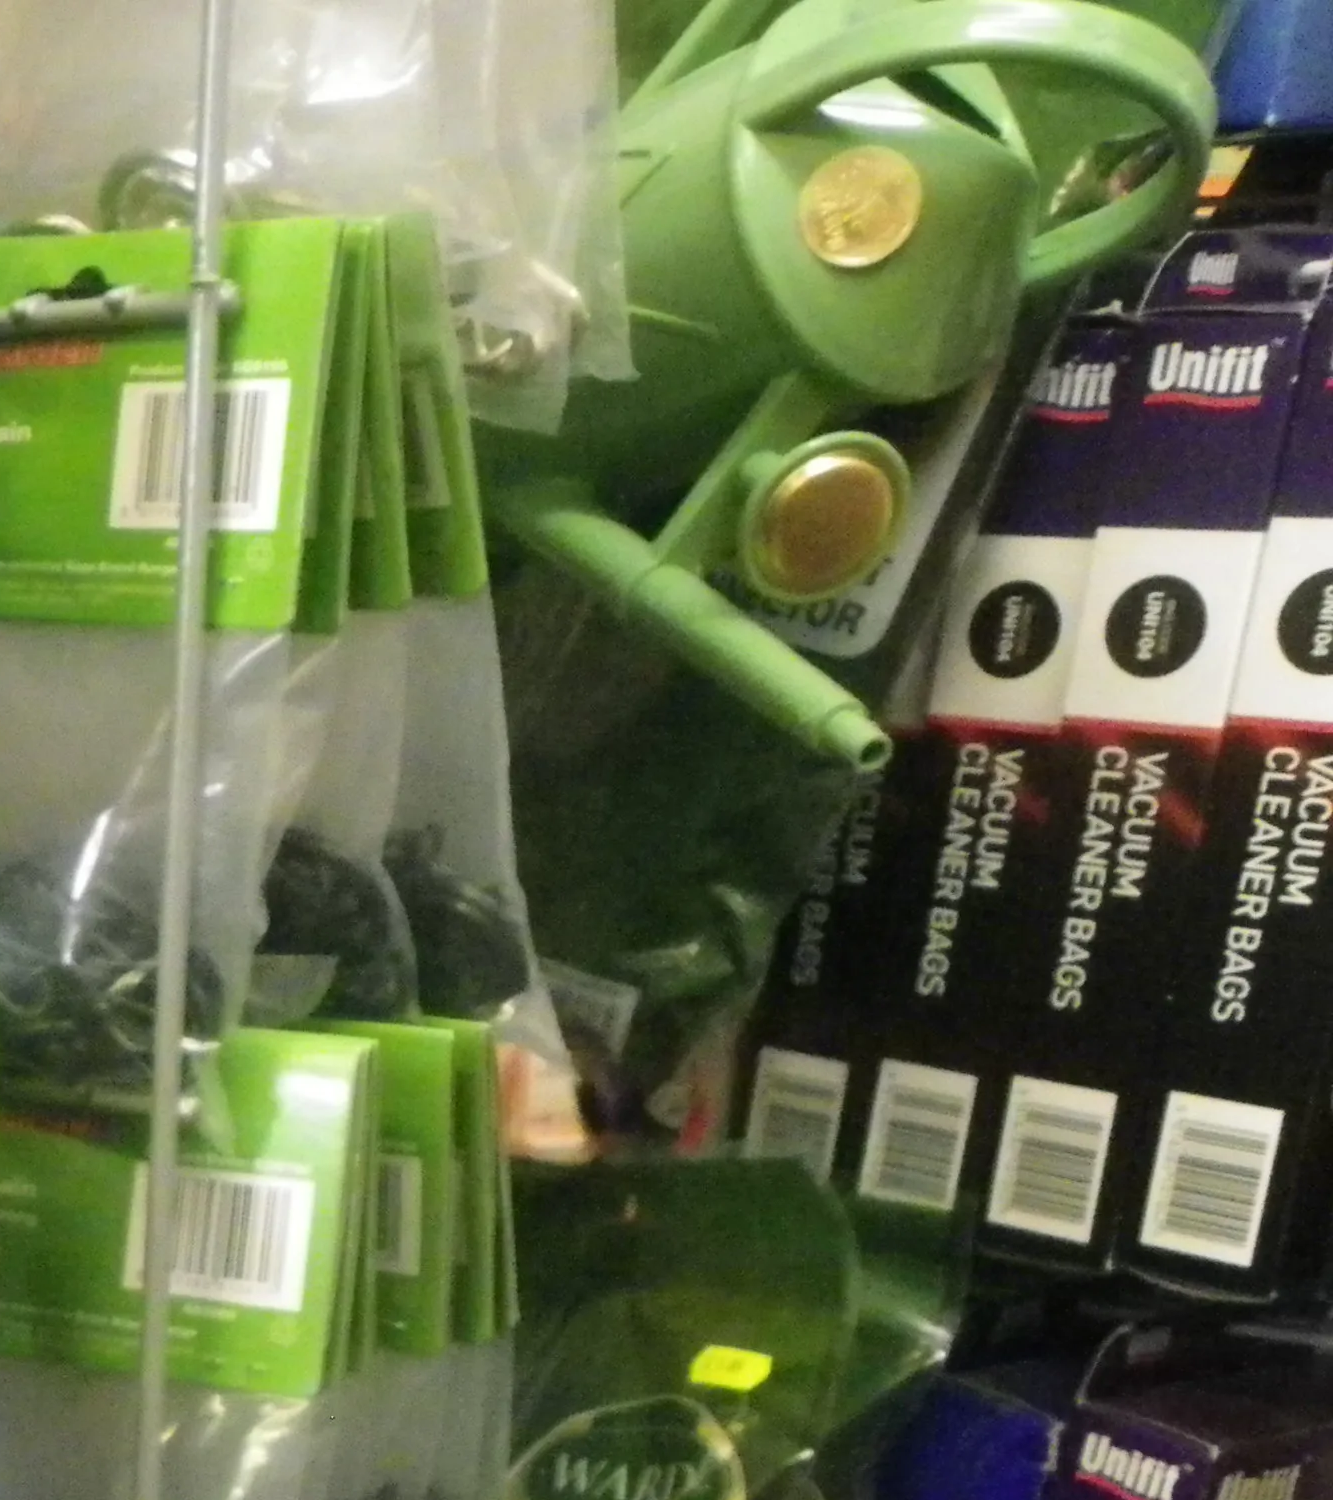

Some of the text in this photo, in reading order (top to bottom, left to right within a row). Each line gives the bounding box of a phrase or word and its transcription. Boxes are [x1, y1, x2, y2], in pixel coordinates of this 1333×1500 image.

[1035, 360, 1117, 407] nifit
[1147, 340, 1269, 394] Unifit
[1134, 591, 1165, 661] UNI104
[914, 742, 989, 998] CLEANER BAGS
[971, 747, 1025, 890] VACUUM
[1049, 744, 1129, 1012] CLEANER BAGS
[1109, 751, 1170, 900] VACUUM
[1211, 746, 1301, 1024] CLEANER BAGS
[1278, 753, 1333, 908] VACUUM
